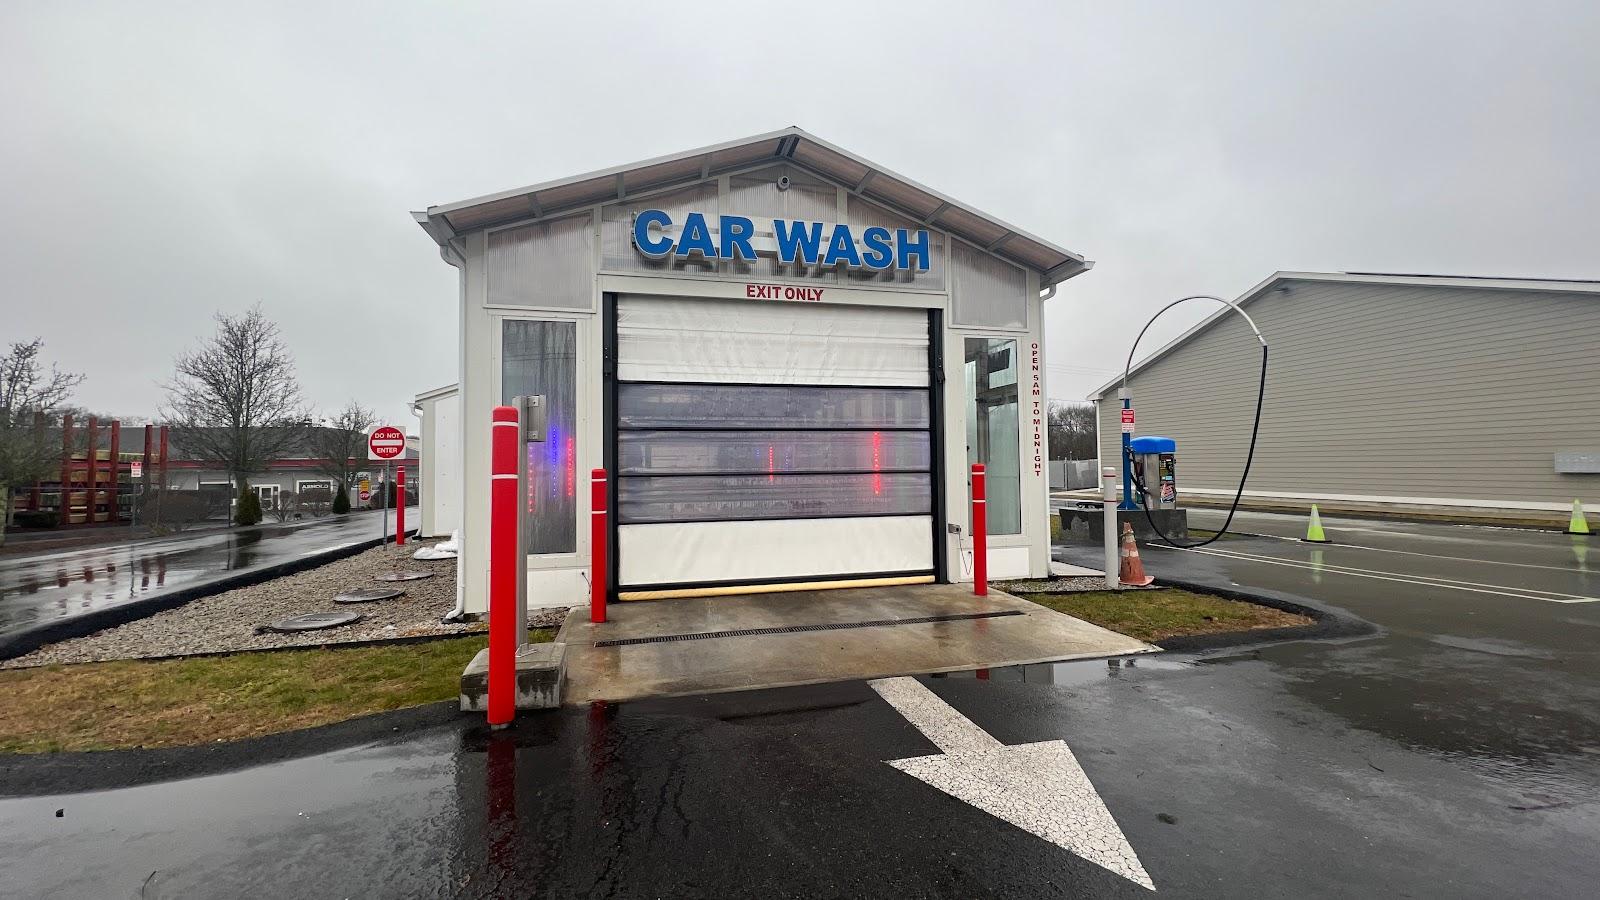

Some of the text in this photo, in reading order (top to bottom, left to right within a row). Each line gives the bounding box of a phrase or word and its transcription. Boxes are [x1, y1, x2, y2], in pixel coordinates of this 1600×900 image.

[633, 208, 931, 272] CAR WASH
[746, 284, 825, 302] EXIT ONLY
[1031, 343, 1041, 477] OPEN 5AM TO MIDNIGHT
